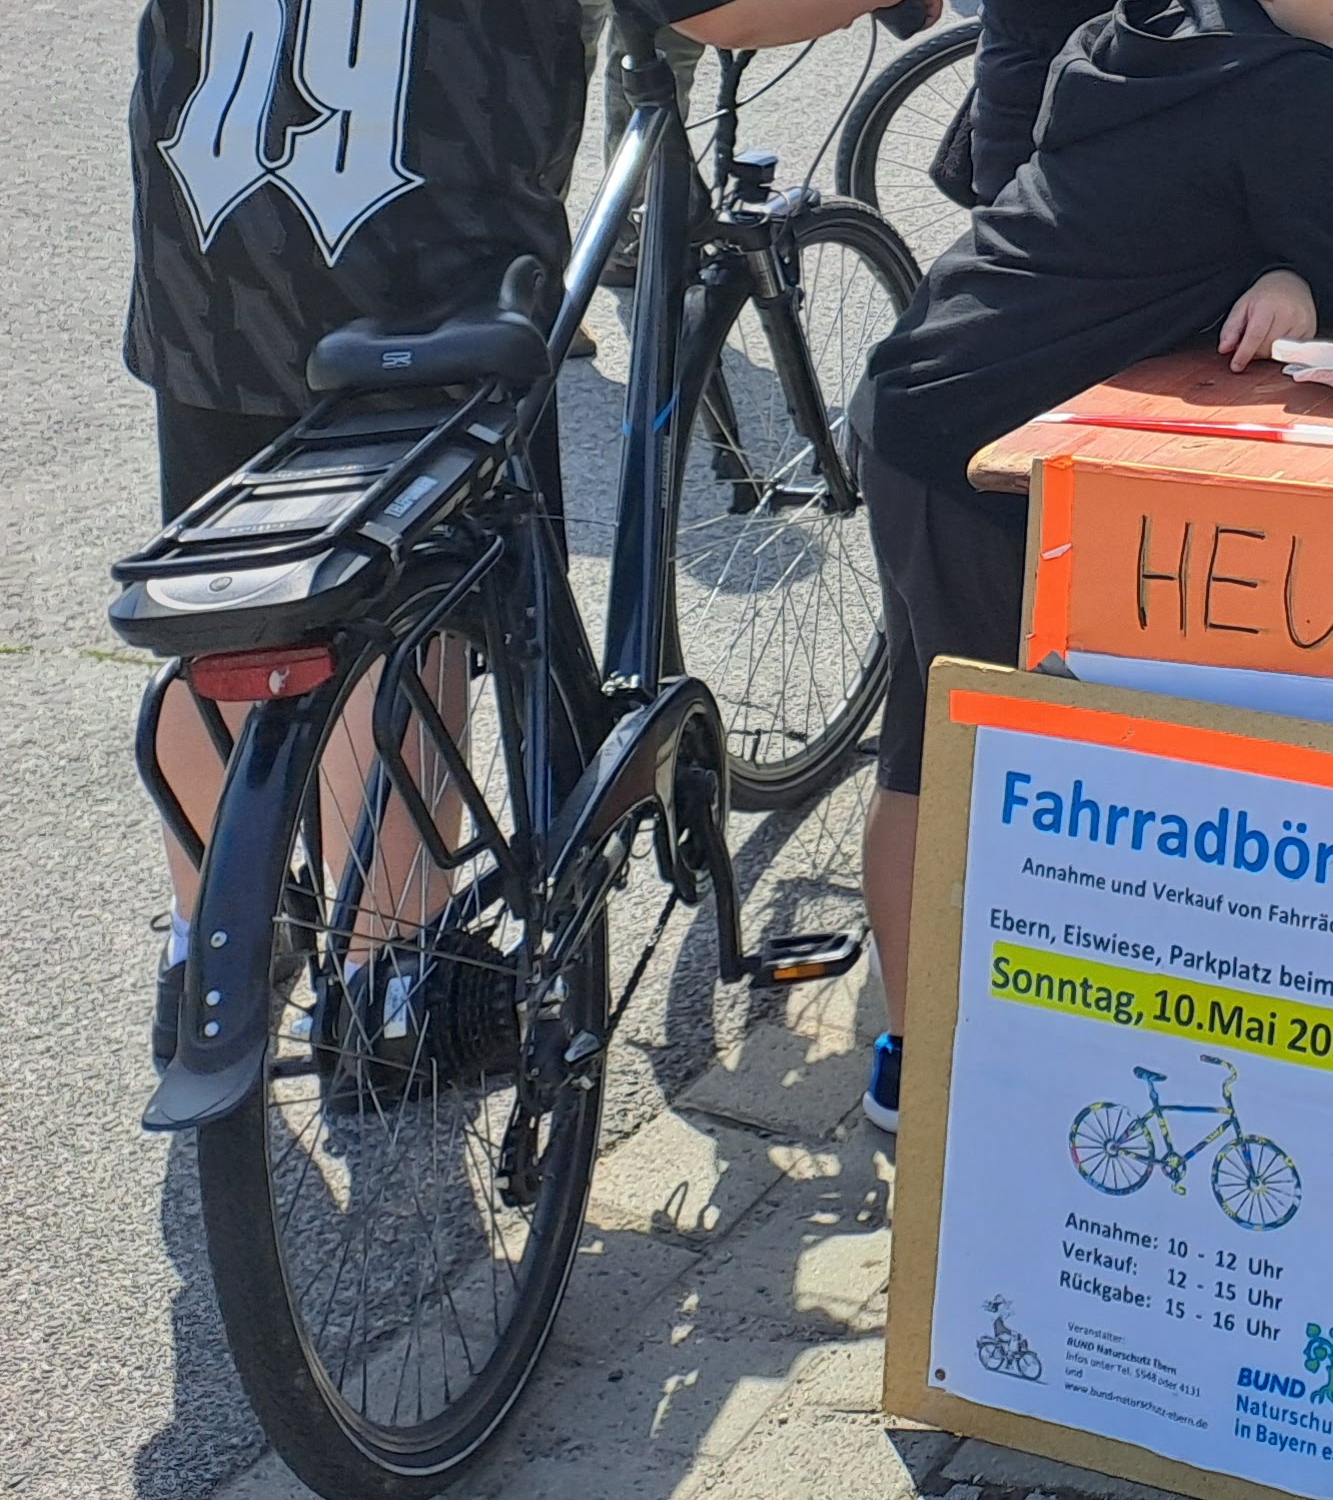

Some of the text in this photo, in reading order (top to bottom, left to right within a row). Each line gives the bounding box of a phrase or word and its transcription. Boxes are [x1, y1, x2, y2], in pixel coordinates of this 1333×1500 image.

[1021, 858, 1106, 890] Annahme
[1111, 880, 1147, 898] und
[1153, 882, 1223, 912] Verkauf
[1228, 901, 1262, 920] von
[990, 908, 1056, 944] Ebern,
[1063, 924, 1162, 966] Eiswiese,
[1169, 945, 1273, 984] Parkplatz
[991, 956, 1144, 1026] Sonntag,
[1062, 1240, 1138, 1275] Verkauf:
[1167, 1268, 1187, 1289] 12
[1214, 1281, 1236, 1301] 15
[1248, 1288, 1283, 1311] Uhr
[1065, 1212, 1158, 1249] Annahme:
[1168, 1237, 1188, 1258] 10
[1215, 1250, 1237, 1271] 12
[1248, 1257, 1284, 1280] Uhr
[1060, 1270, 1151, 1308] Rückgabe:
[1165, 1298, 1185, 1319] 15
[1212, 1311, 1235, 1331] 16
[1247, 1318, 1281, 1341] Uhr
[1065, 1367, 1083, 1379] und
[1066, 1351, 1088, 1364] Infos
[1158, 1376, 1178, 1391] oder
[1067, 1337, 1095, 1351] BUND
[1096, 1343, 1152, 1366] Naturschutz
[1236, 1367, 1306, 1399] BUND
[1256, 1424, 1317, 1456] Bayern
